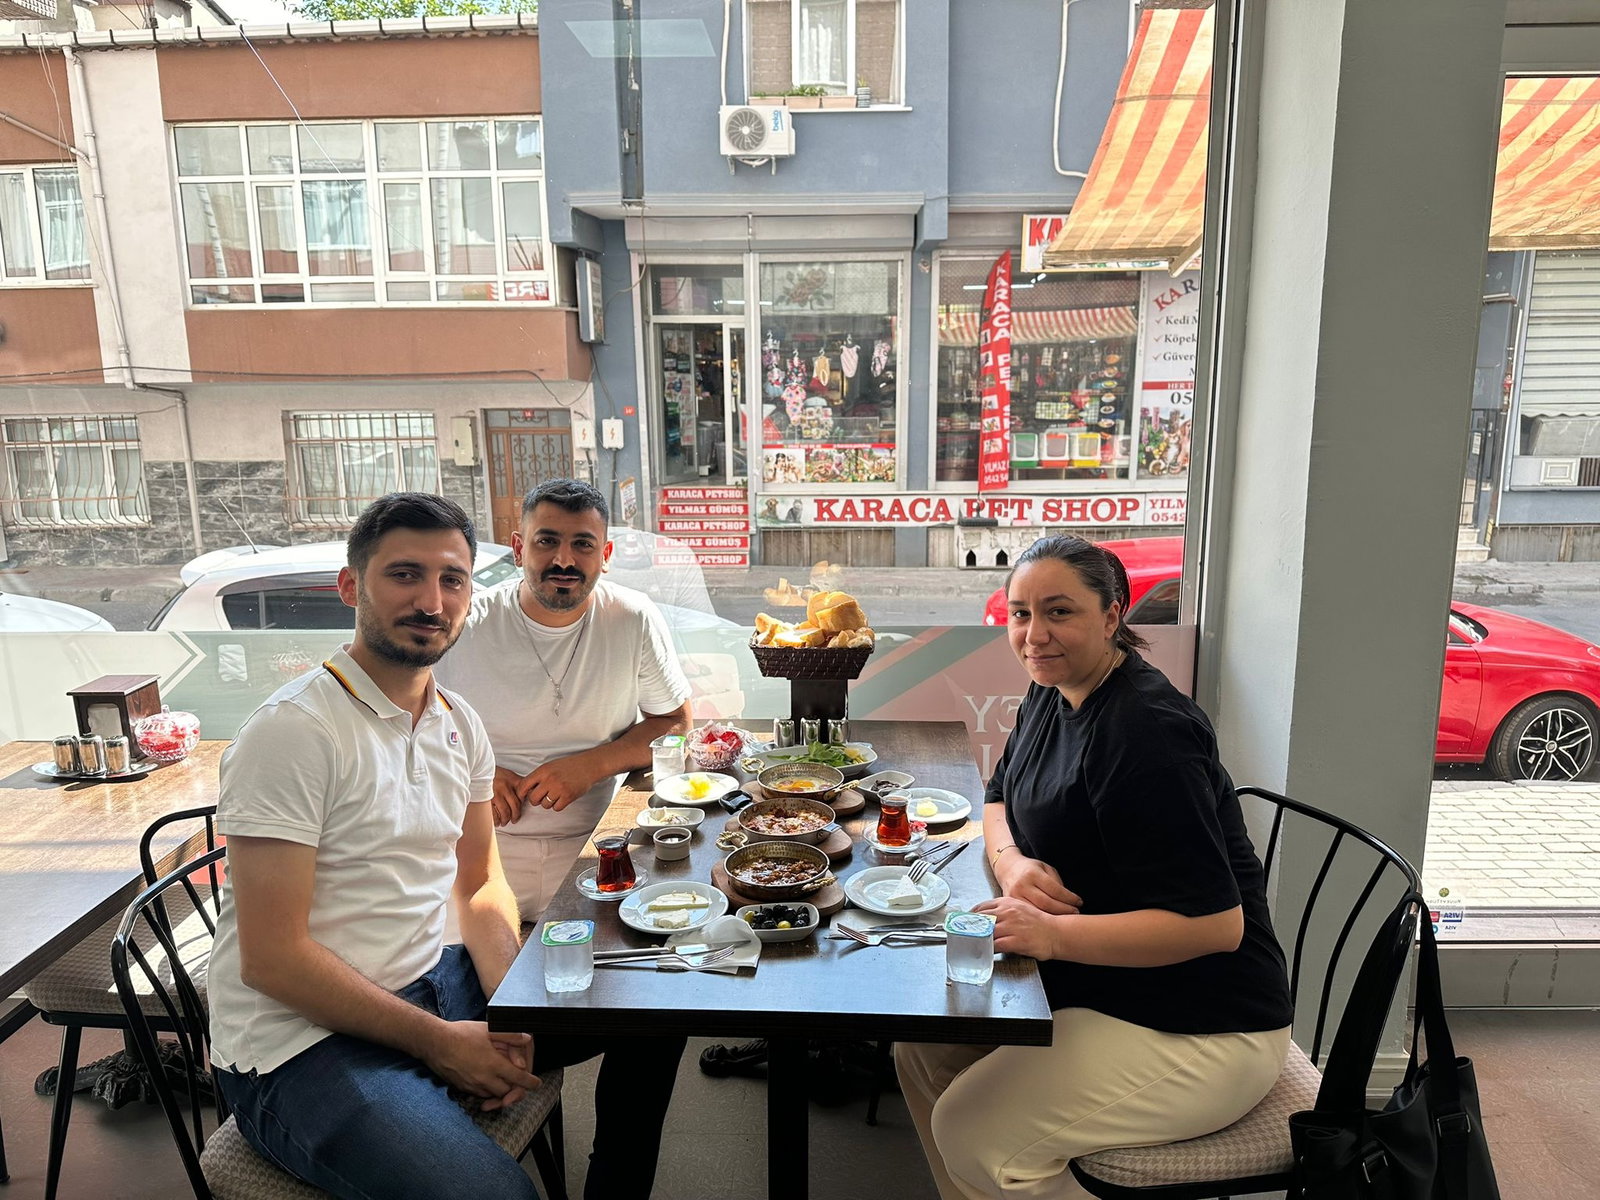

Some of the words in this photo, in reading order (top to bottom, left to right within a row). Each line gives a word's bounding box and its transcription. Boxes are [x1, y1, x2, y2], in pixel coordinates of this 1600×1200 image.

[771, 110, 779, 131] beko
[1153, 279, 1199, 312] KAR
[992, 261, 1010, 342] KARACA
[1165, 315, 1189, 325] Kedi
[1164, 333, 1197, 345] Köpek
[1163, 351, 1196, 361] Güver
[1170, 391, 1193, 405] 05
[667, 490, 703, 499] KARACA
[1149, 499, 1186, 509] YILM
[668, 506, 707, 514] YILMAZ
[708, 505, 744, 515] GÜMÜŞ
[814, 498, 954, 522] KARACA
[963, 498, 1032, 521] PET
[1042, 498, 1140, 522] SHOP
[664, 521, 701, 531] KARACA
[703, 521, 746, 531] PETSHOP
[705, 538, 742, 548] GÜMÜŞ
[697, 555, 742, 564] PETSHOP
